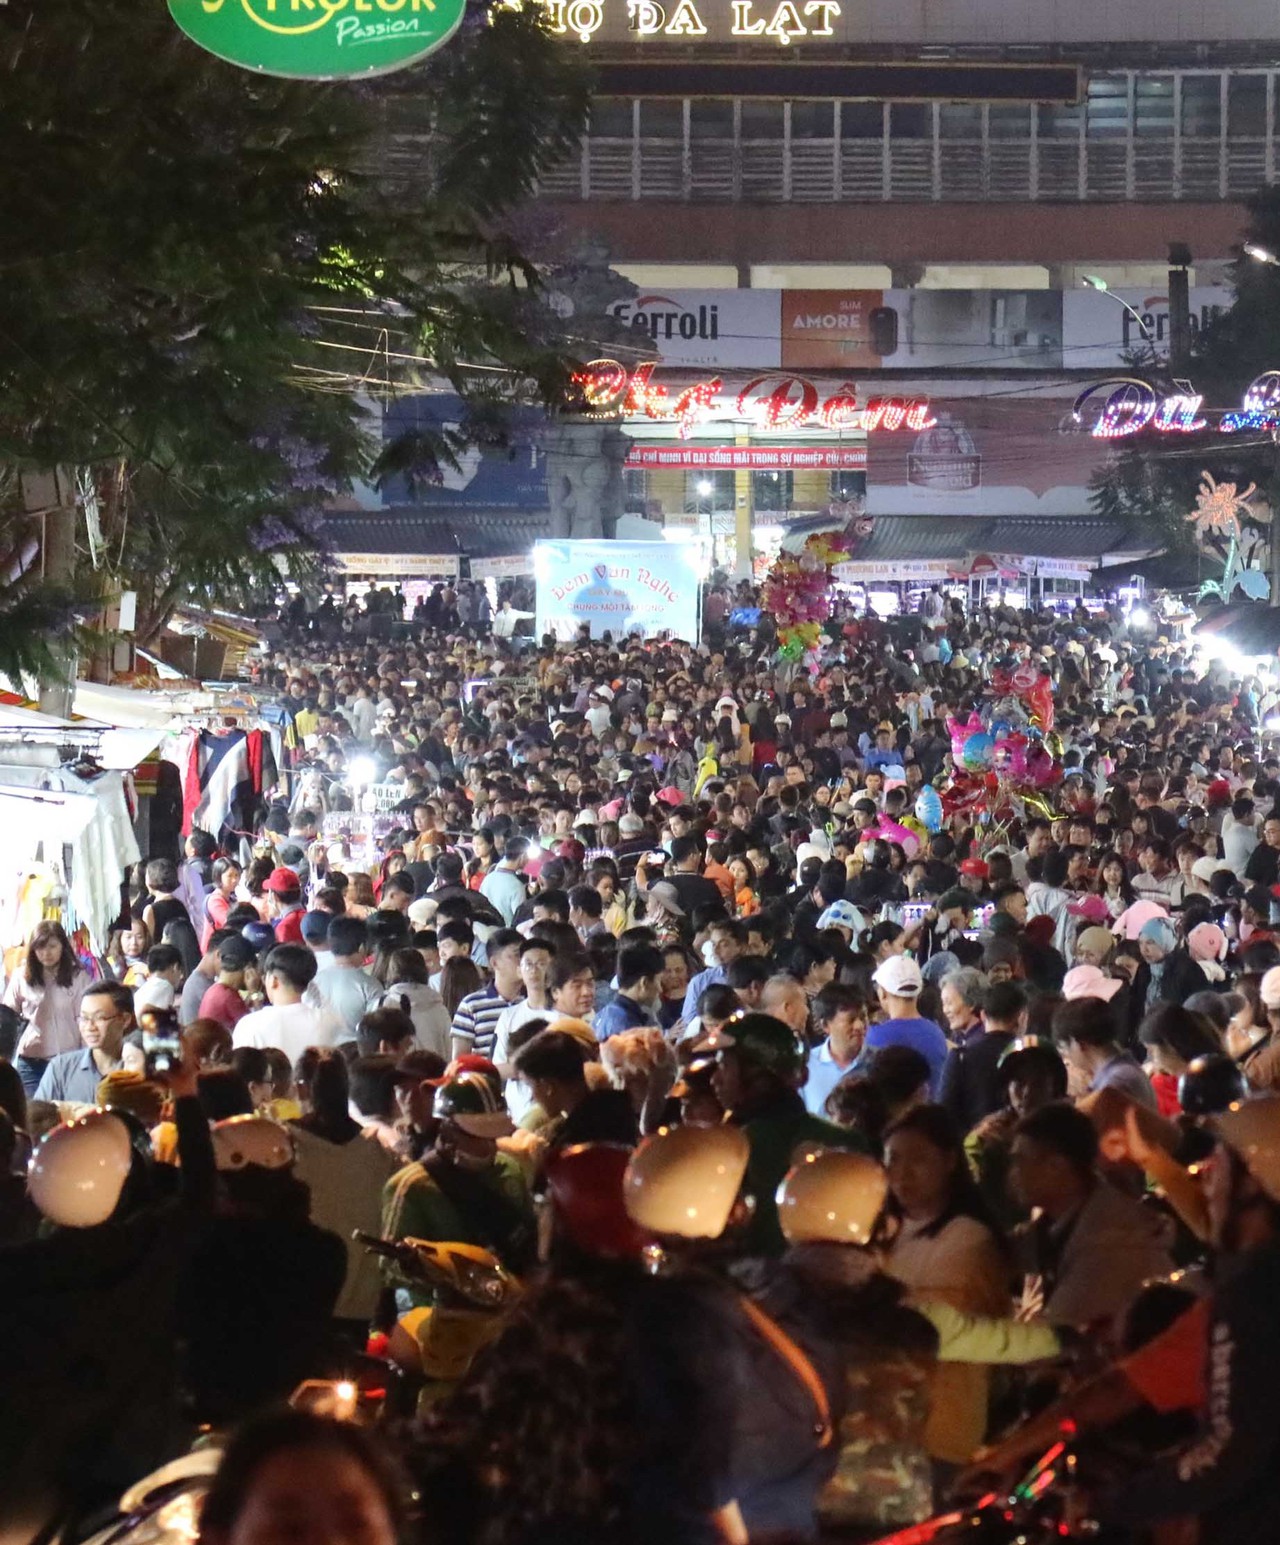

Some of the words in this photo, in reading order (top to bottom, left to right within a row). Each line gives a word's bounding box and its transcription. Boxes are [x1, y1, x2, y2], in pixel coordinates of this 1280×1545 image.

[336, 16, 419, 46] Passion
[731, 0, 841, 44] LẠT
[792, 313, 862, 329] AMORE
[659, 452, 681, 464] MINH
[752, 452, 779, 464] TRONG
